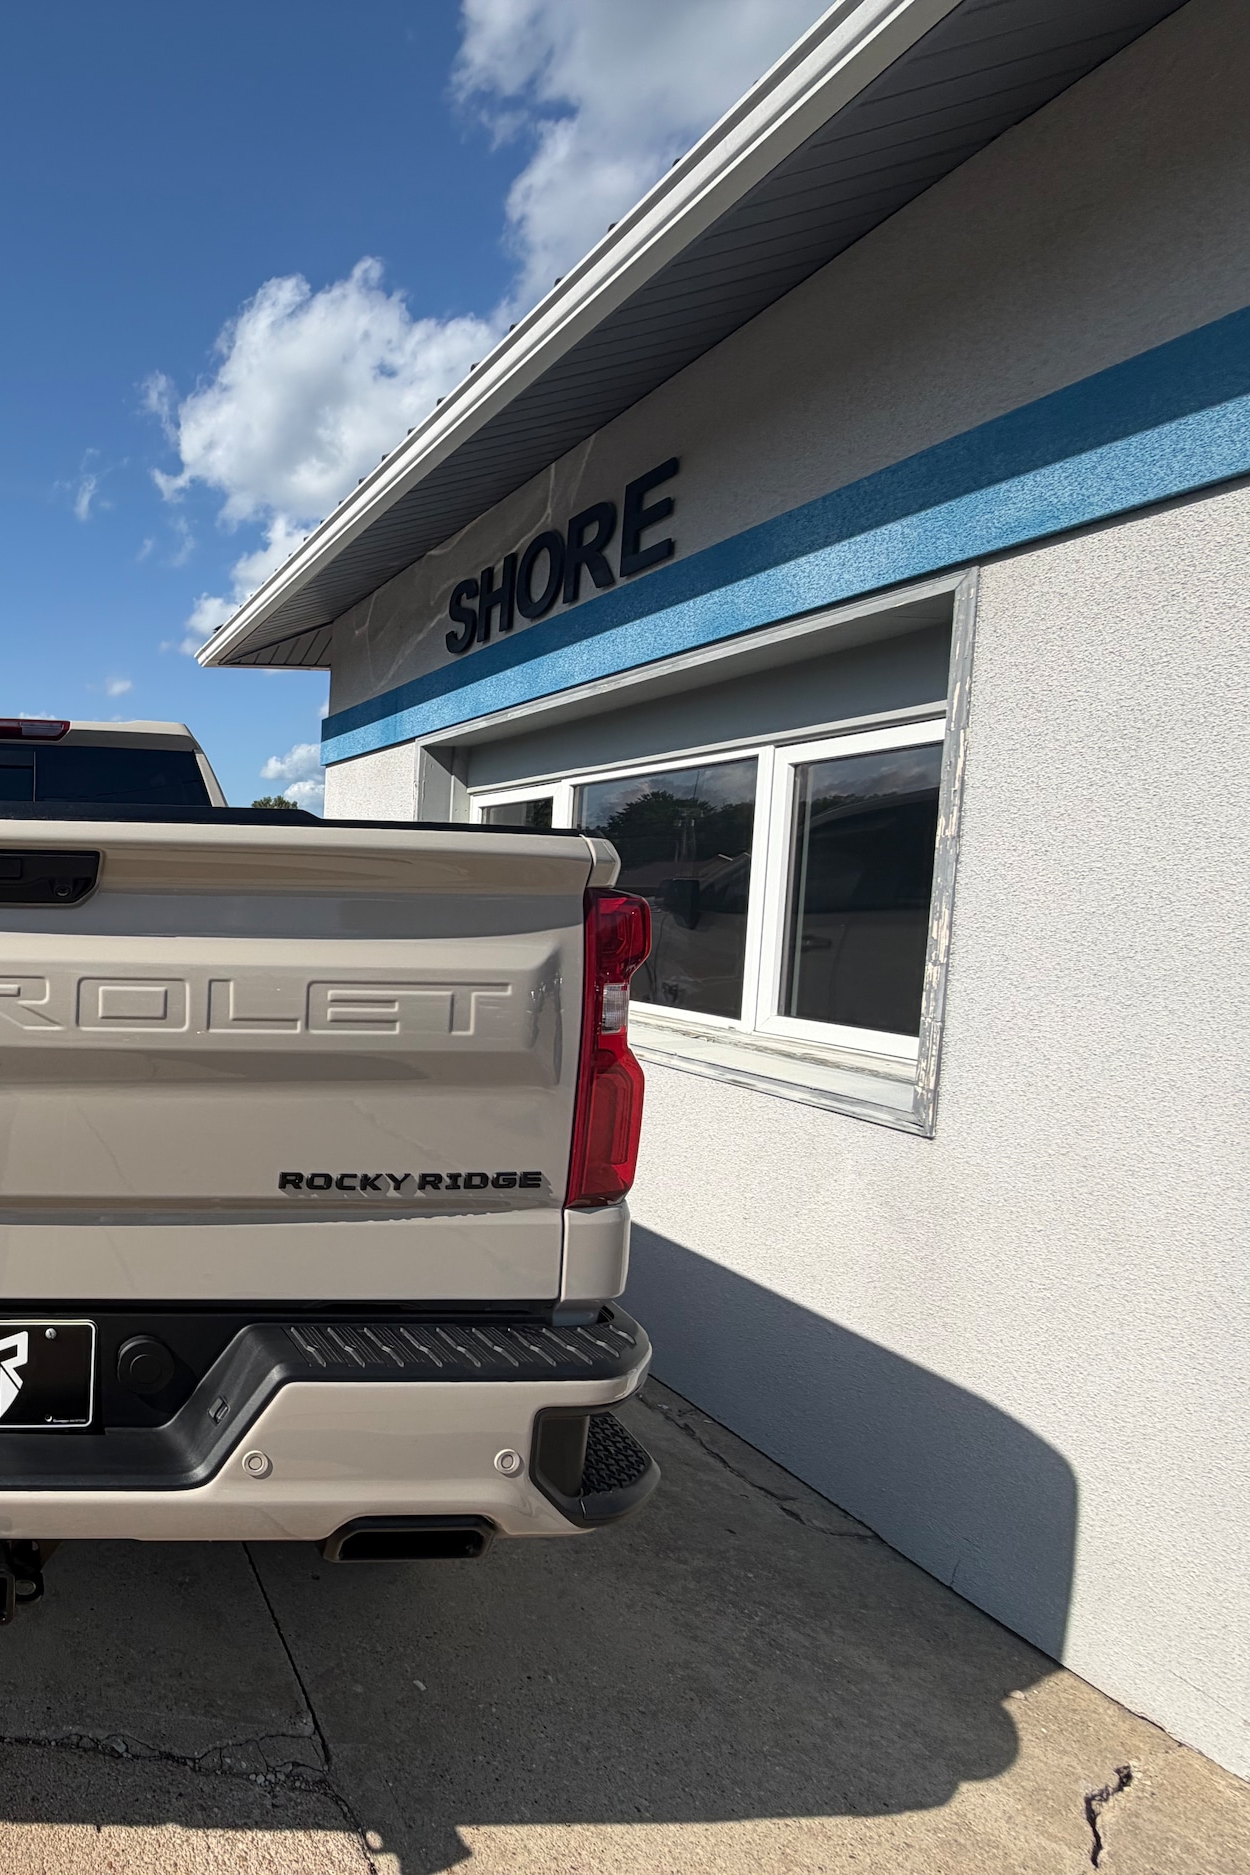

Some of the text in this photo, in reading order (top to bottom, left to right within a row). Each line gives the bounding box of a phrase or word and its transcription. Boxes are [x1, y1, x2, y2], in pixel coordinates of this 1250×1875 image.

[446, 456, 679, 653] SHORE
[278, 1171, 543, 1191] ROCKY RIDGE
